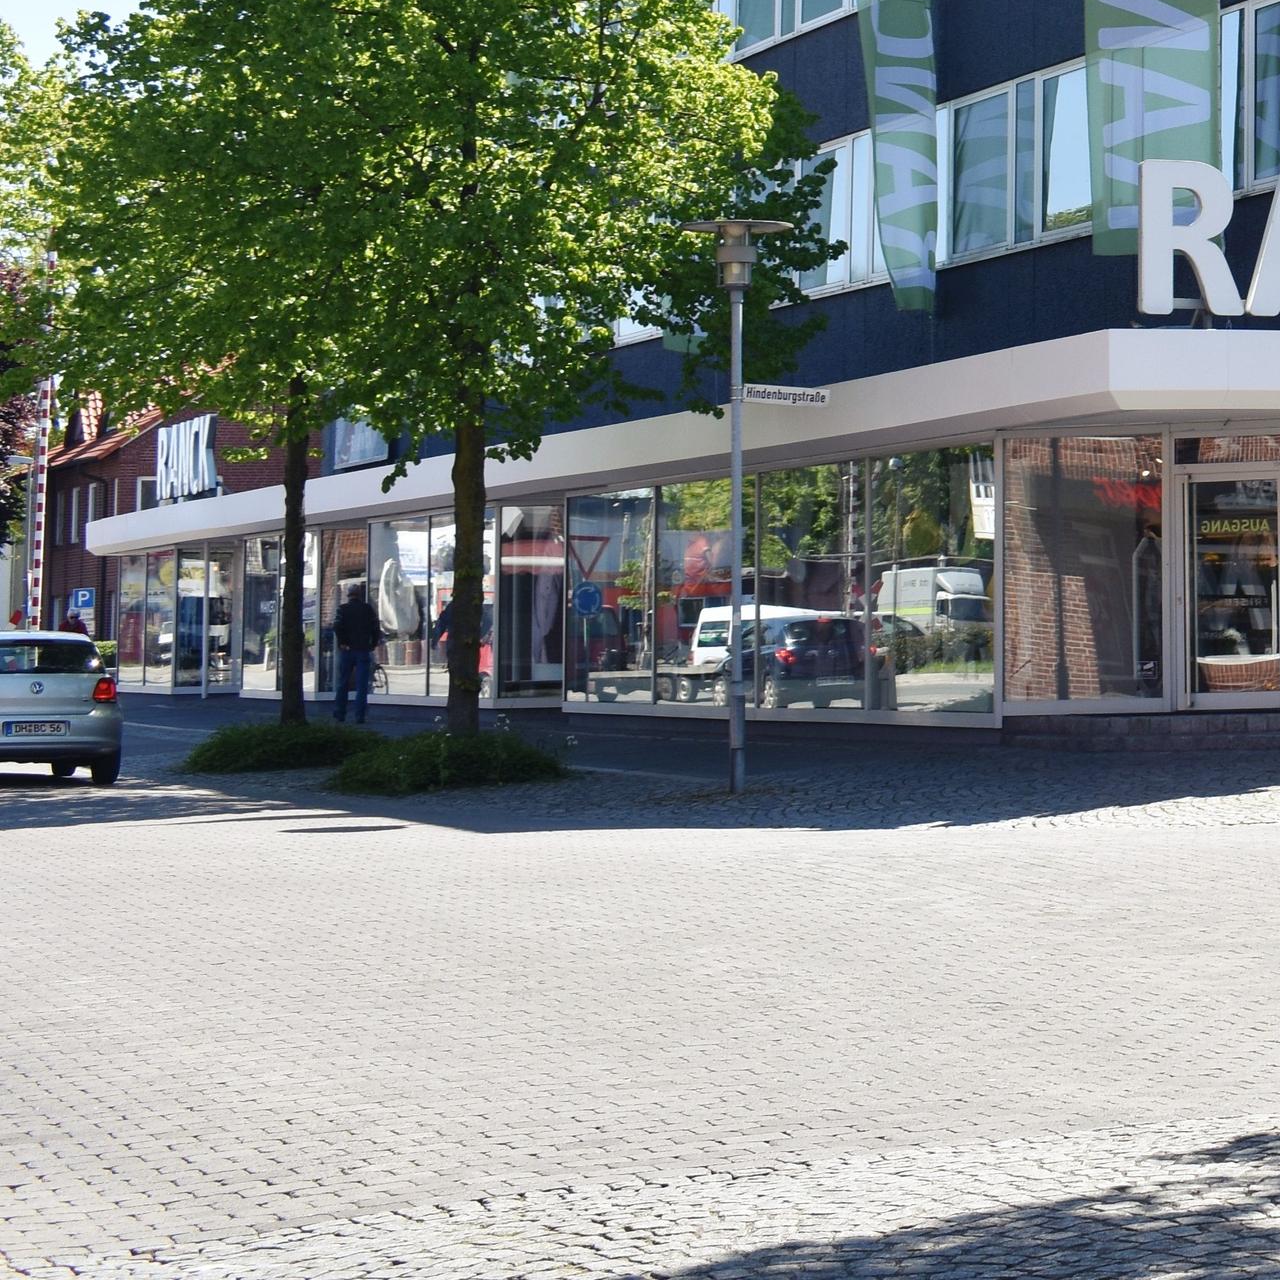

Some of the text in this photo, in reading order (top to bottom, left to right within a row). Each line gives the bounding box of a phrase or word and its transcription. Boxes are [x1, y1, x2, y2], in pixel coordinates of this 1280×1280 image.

[746, 387, 826, 404] Hindenburgstraße
[157, 414, 214, 500] RANCK
[78, 591, 90, 606] P
